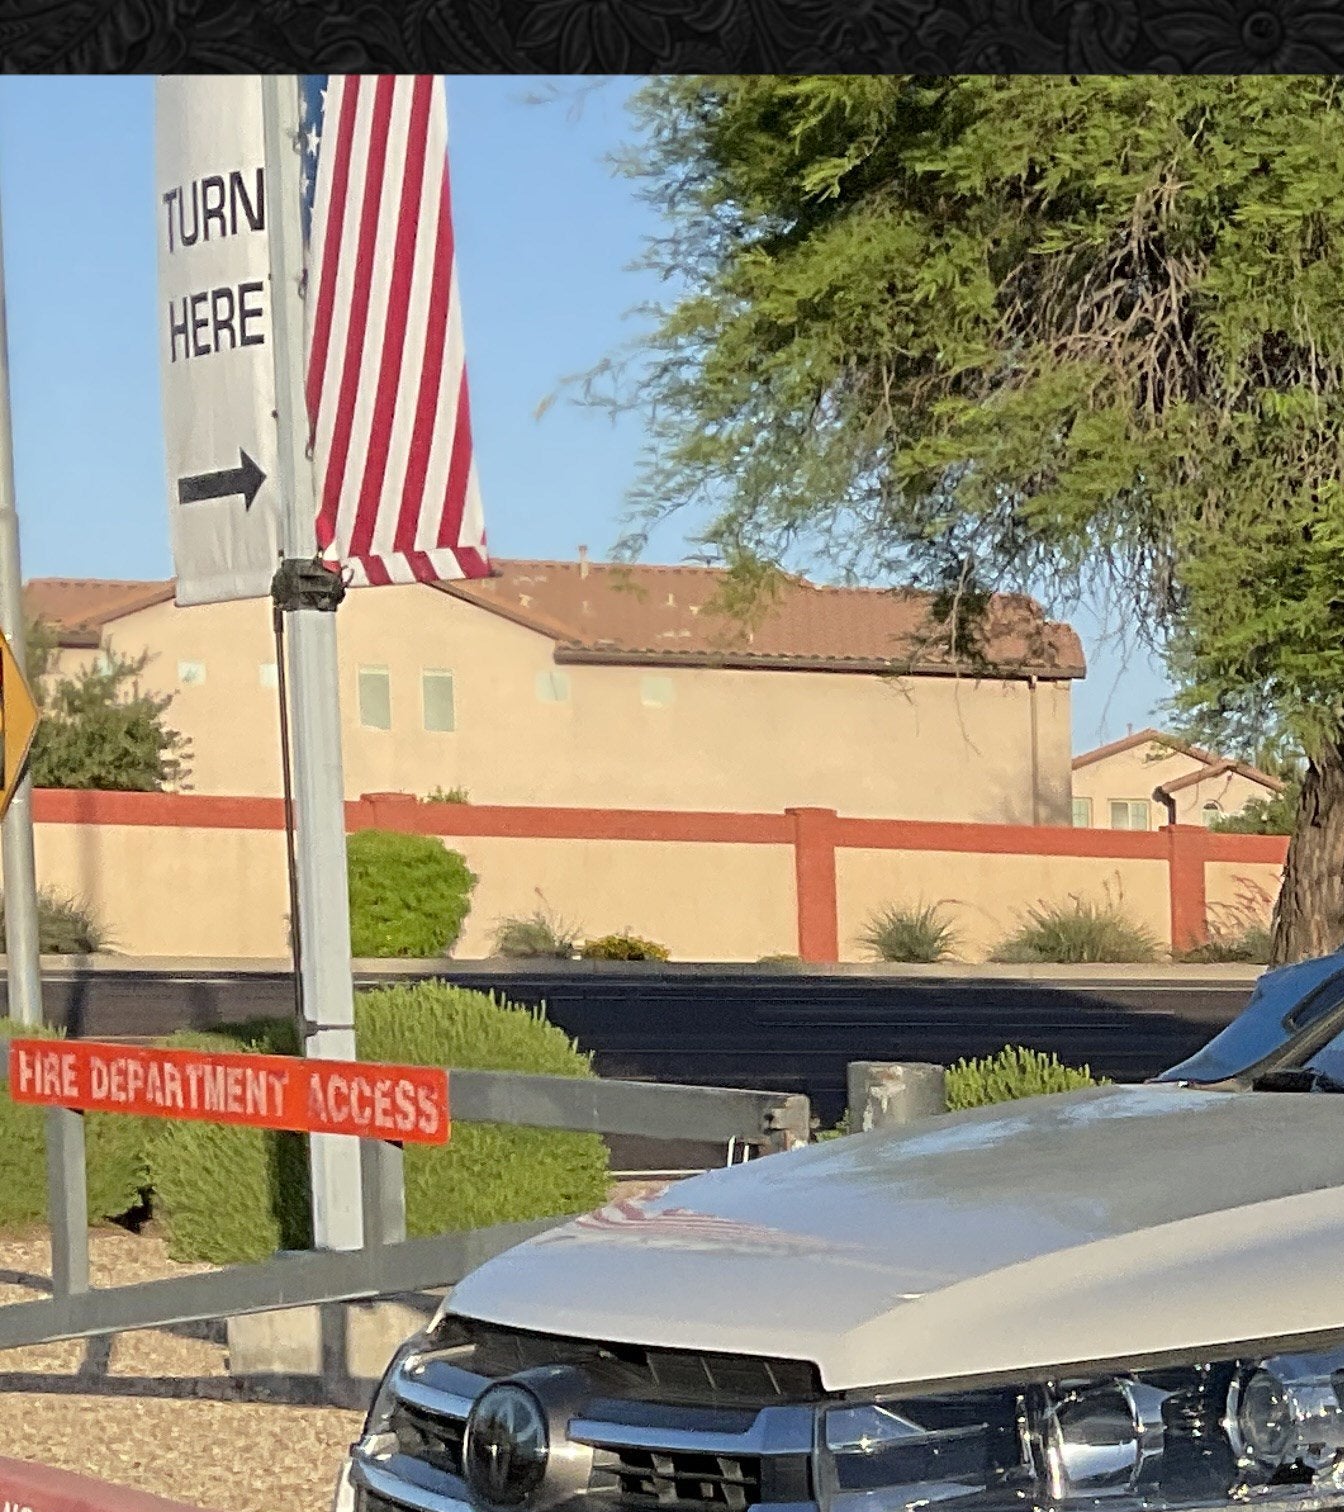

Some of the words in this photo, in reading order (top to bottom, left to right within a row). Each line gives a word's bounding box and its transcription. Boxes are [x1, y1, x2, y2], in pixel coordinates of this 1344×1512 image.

[162, 168, 265, 253] TURN
[169, 281, 264, 363] HERE
[18, 1050, 79, 1098] FIRE
[90, 1055, 290, 1117] DEPARTMENT
[308, 1072, 439, 1134] ACCESS
